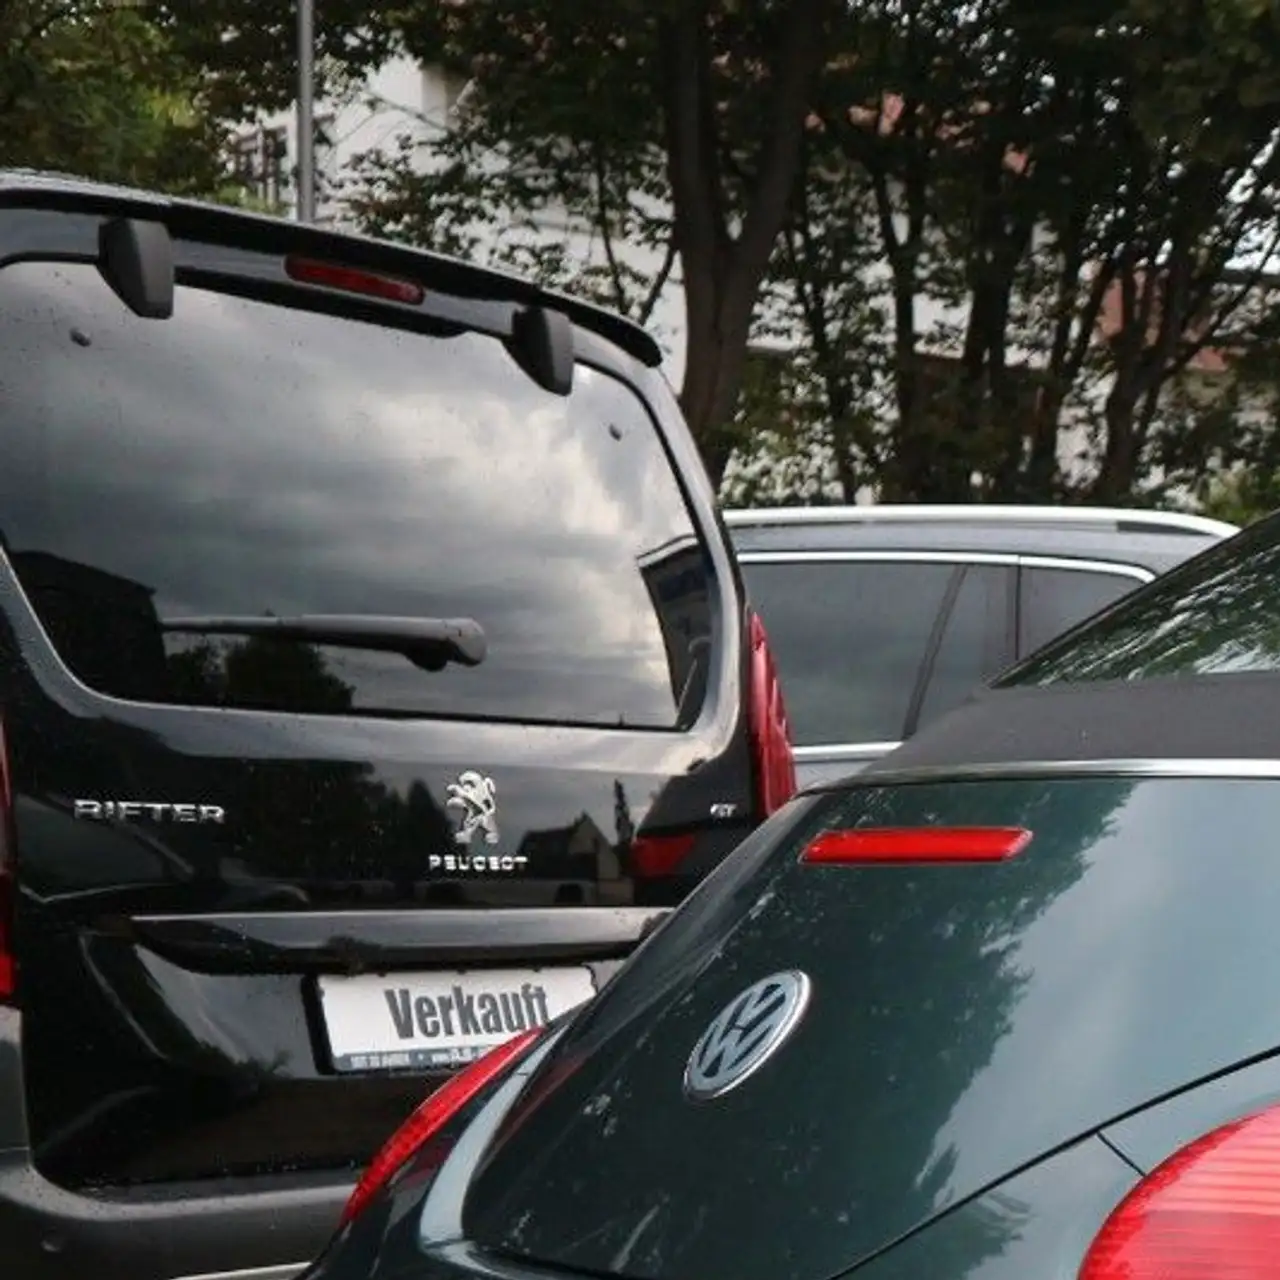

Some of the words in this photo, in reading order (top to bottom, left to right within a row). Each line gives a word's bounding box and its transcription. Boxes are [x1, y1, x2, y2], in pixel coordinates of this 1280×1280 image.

[74, 799, 226, 825] RIFTER
[429, 855, 528, 872] PEUGEOT
[384, 982, 550, 1041] Verkauft
